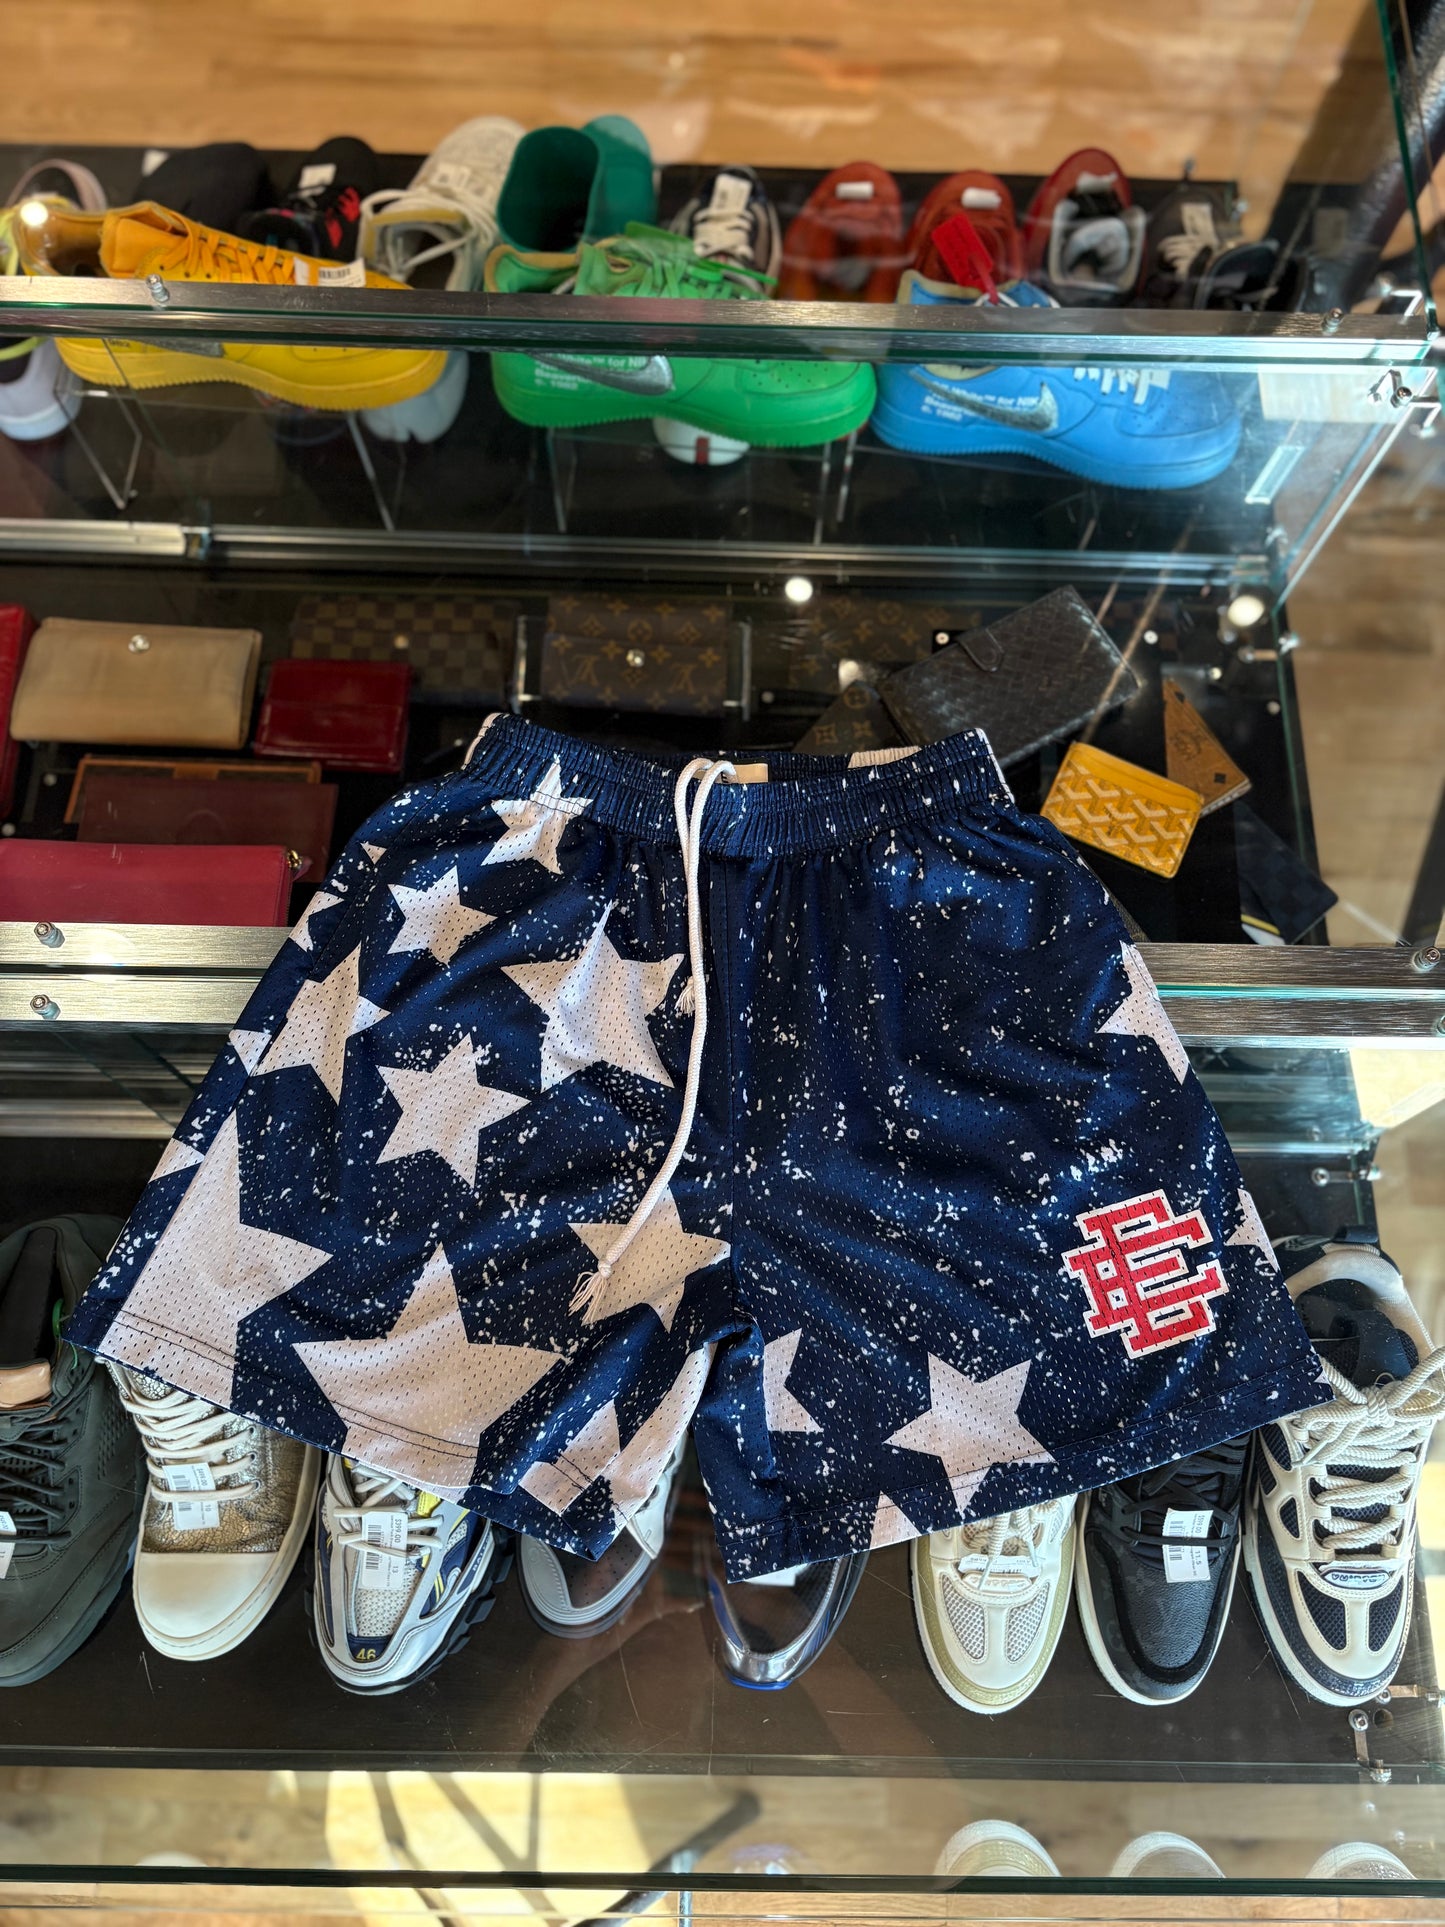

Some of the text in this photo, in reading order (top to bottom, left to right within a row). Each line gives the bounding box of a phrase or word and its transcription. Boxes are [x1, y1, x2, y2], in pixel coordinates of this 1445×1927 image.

[608, 357, 625, 367] for
[394, 1518, 403, 1543] $399.00
[356, 1648, 376, 1660] 46
